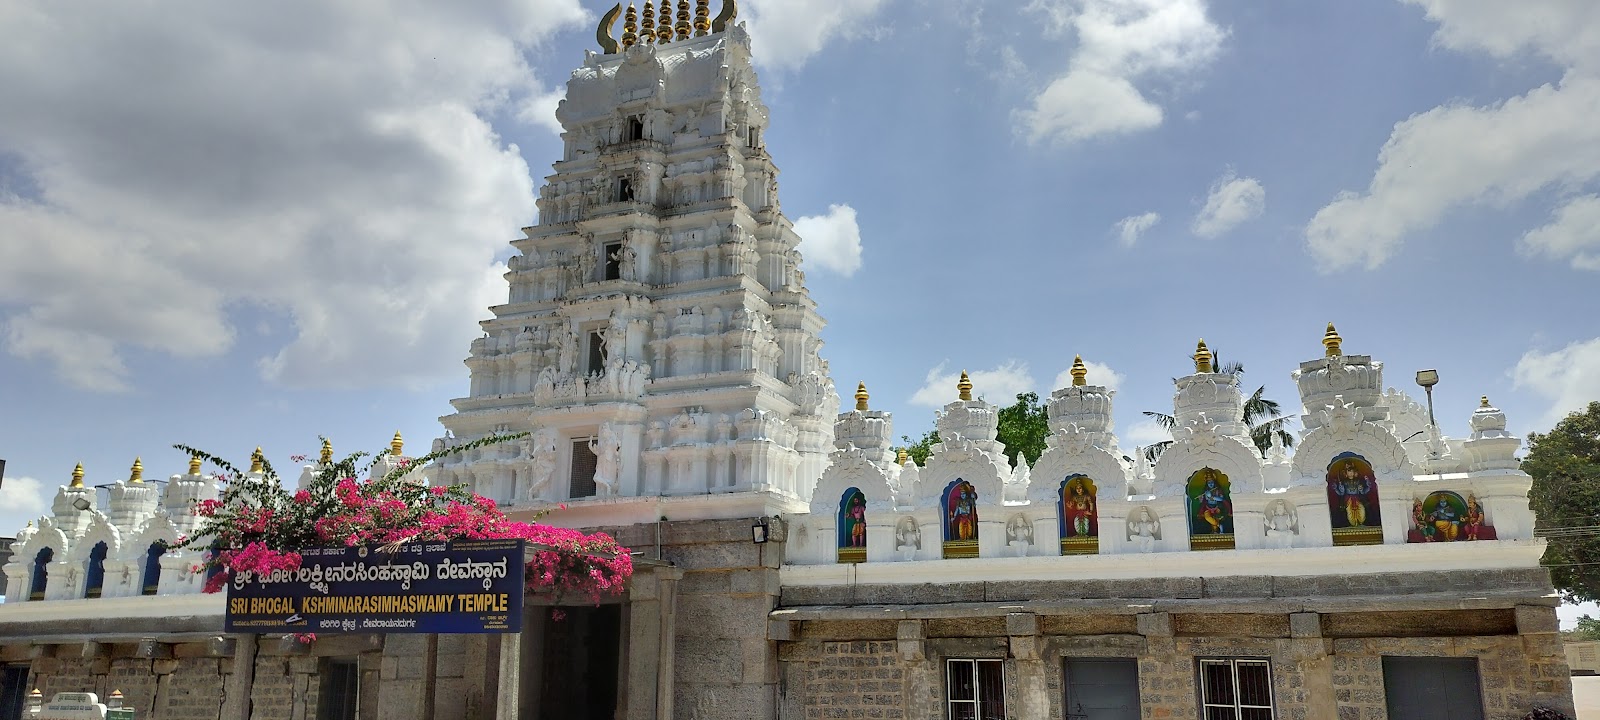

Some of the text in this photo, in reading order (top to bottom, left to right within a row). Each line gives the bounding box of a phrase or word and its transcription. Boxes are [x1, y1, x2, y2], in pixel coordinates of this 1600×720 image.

[436, 556, 508, 591] ದೇವಸ್ಥಾನ
[230, 593, 509, 614] SRI BHOGAL KSHMINARASIMHASWAMY TEMPLE
